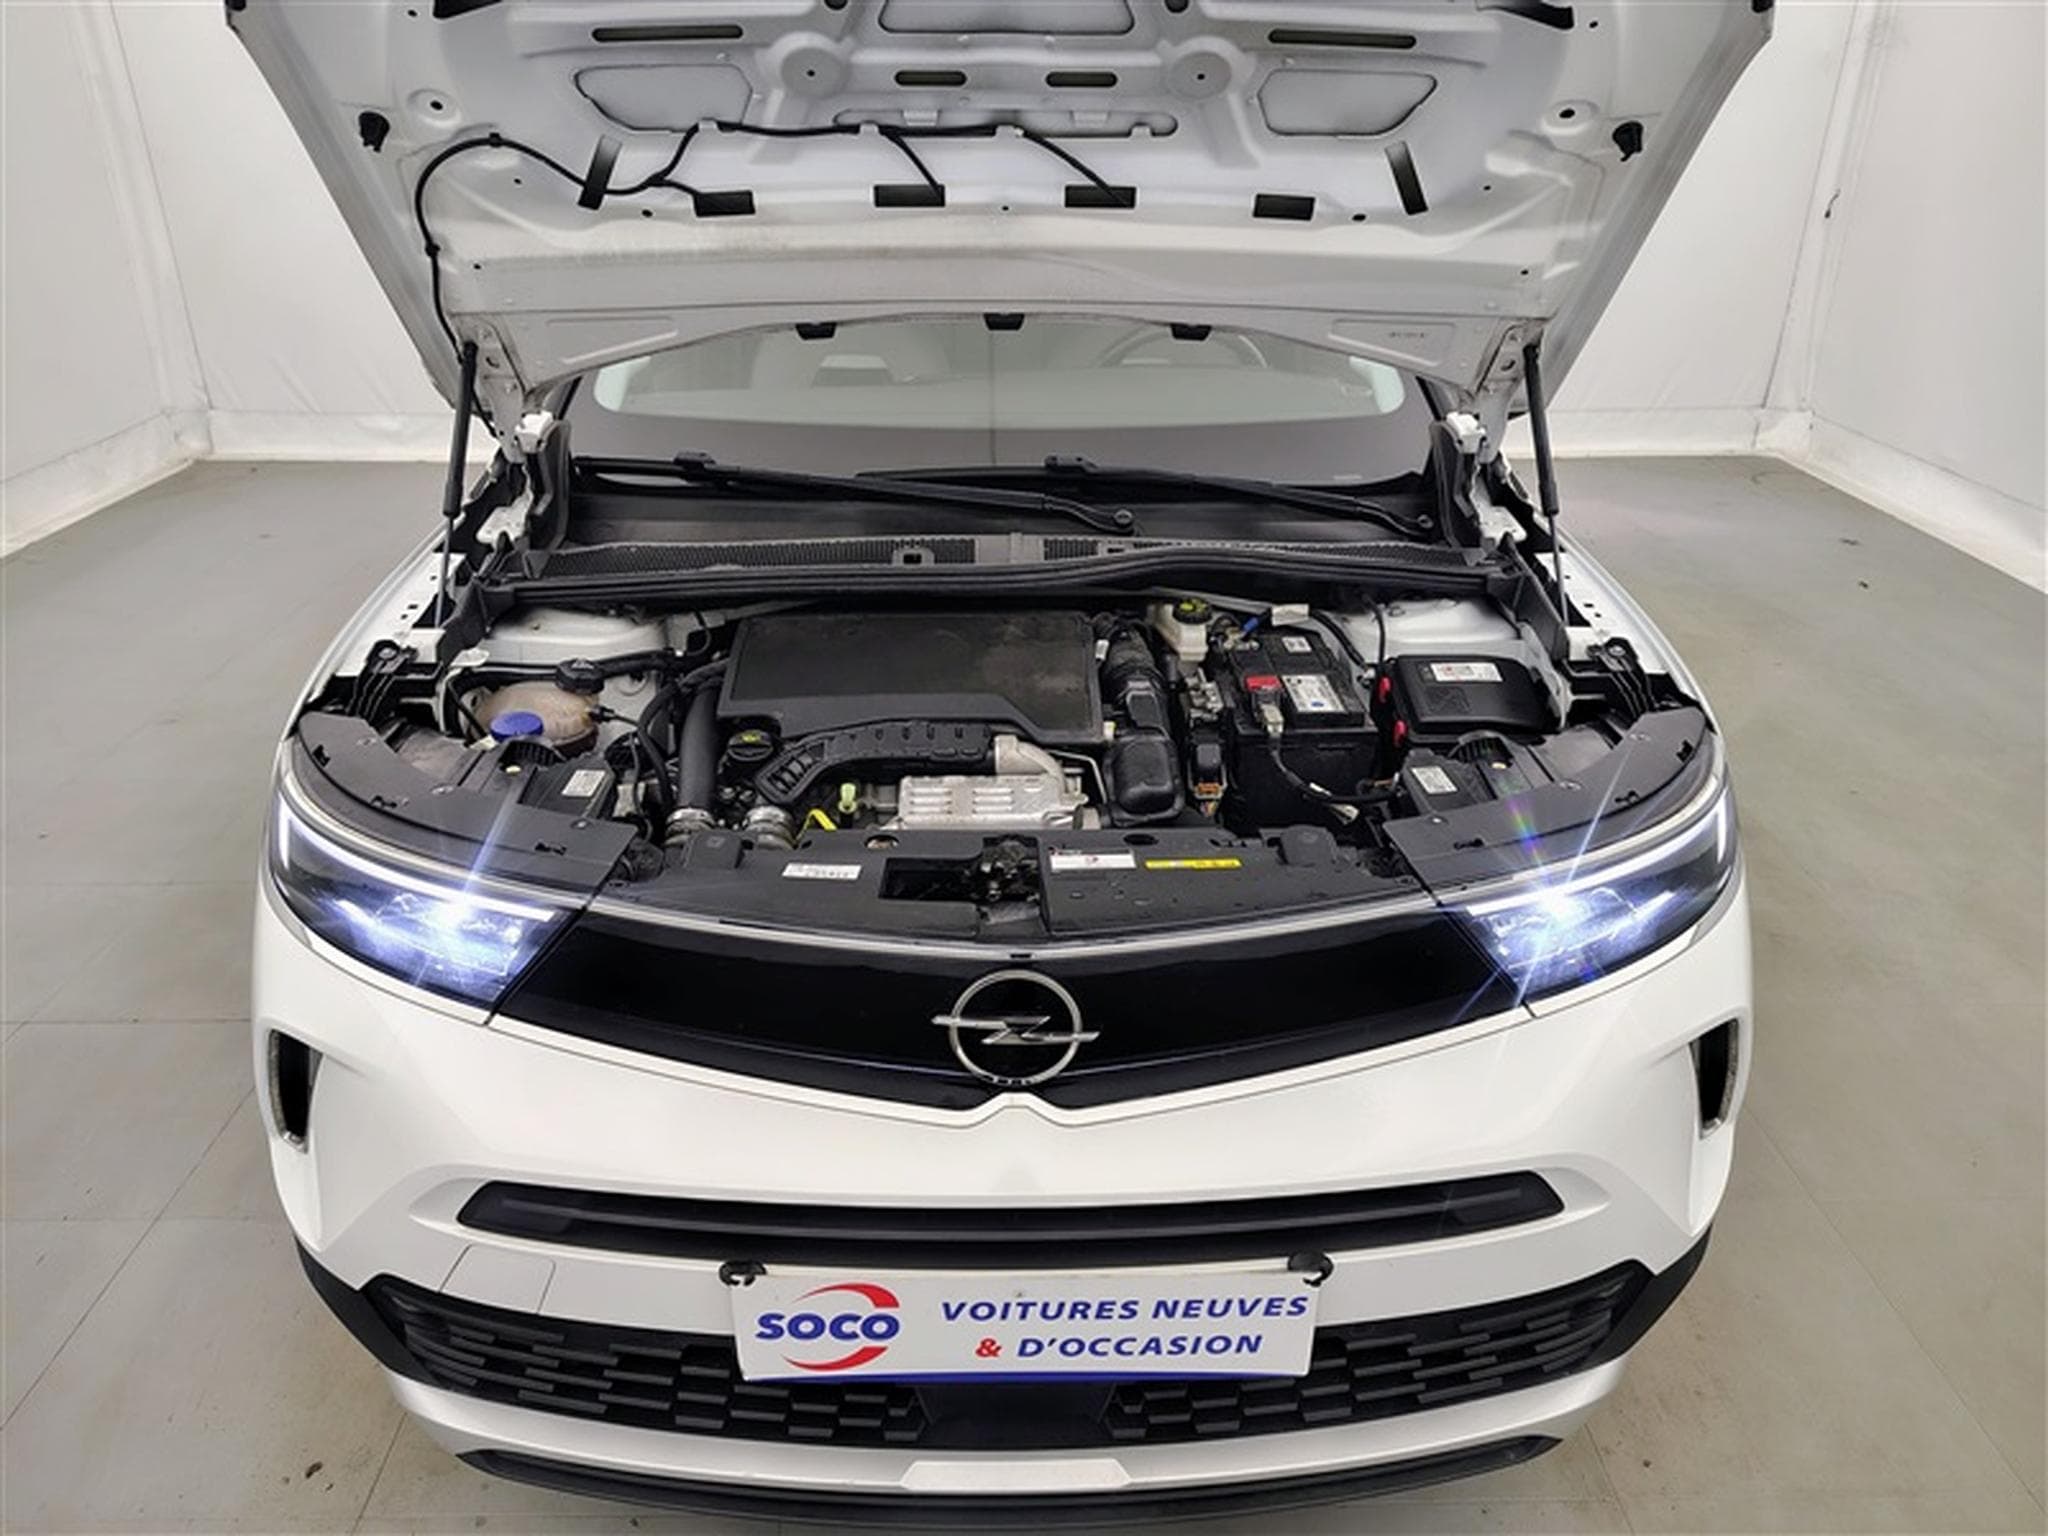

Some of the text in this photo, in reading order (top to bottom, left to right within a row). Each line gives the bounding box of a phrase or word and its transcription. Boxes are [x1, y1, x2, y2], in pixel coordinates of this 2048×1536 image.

[942, 1296, 1308, 1322] VOITURES NEUVES
[755, 1312, 900, 1341] SOCO
[975, 1334, 1263, 1358] & D'OCCASION
